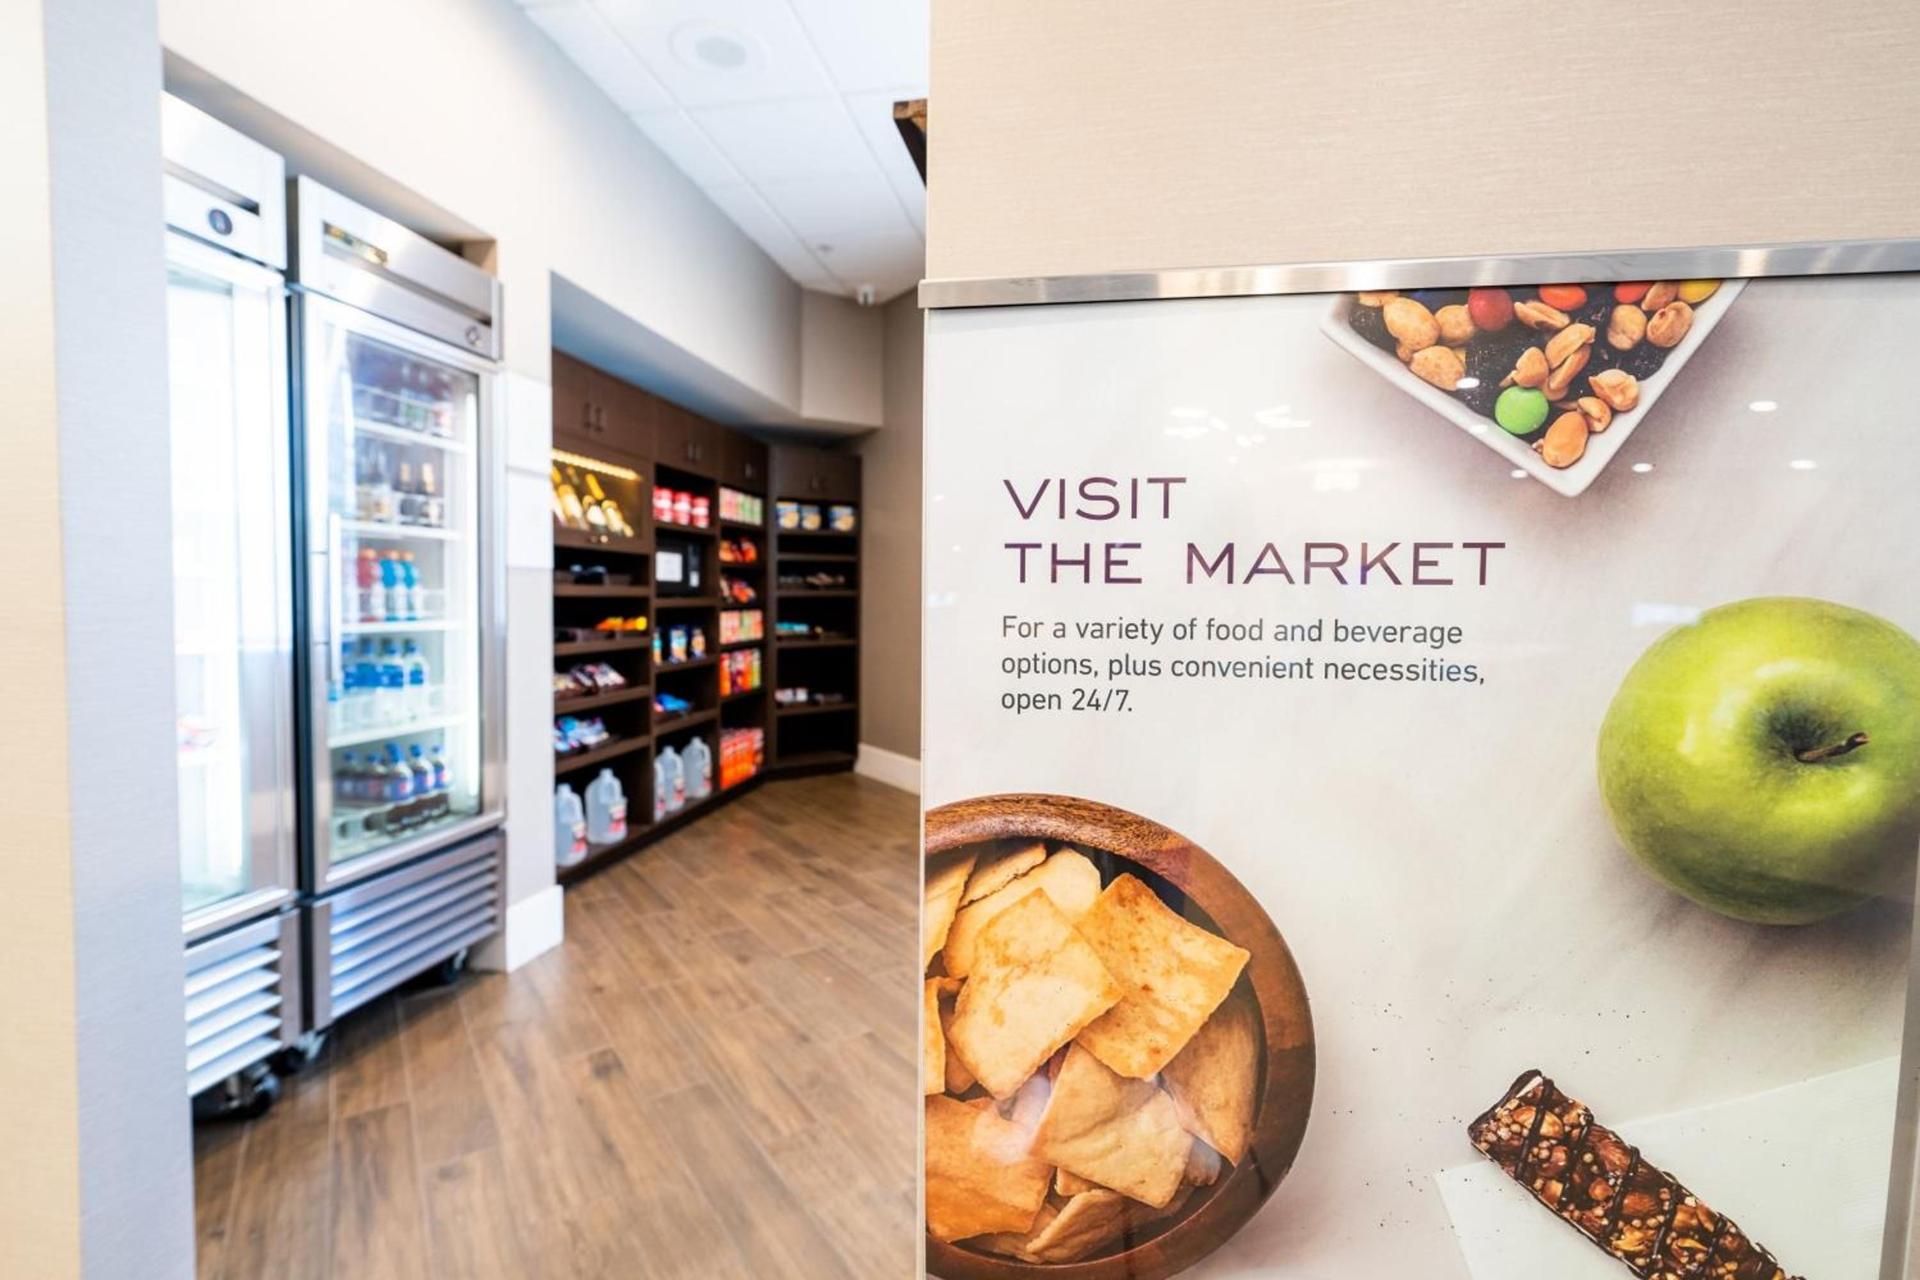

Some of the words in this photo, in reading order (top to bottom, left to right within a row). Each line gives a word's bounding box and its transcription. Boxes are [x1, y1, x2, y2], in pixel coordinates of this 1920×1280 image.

[1003, 476, 1186, 521] VISIT
[1004, 542, 1142, 584] THE
[1187, 542, 1506, 586] MARKET
[1002, 615, 1044, 638] For
[1052, 622, 1066, 639] a
[1075, 617, 1164, 645] variety
[1172, 617, 1197, 641] of
[1206, 617, 1263, 641] food
[1273, 618, 1323, 642] and
[1333, 618, 1463, 650] beverage
[1001, 652, 1099, 679] options,
[1107, 653, 1162, 681] plus
[1170, 655, 1314, 680] convenient
[1323, 657, 1485, 685] necessities,
[1001, 692, 1062, 715] open
[1071, 688, 1133, 713] 24/7.
